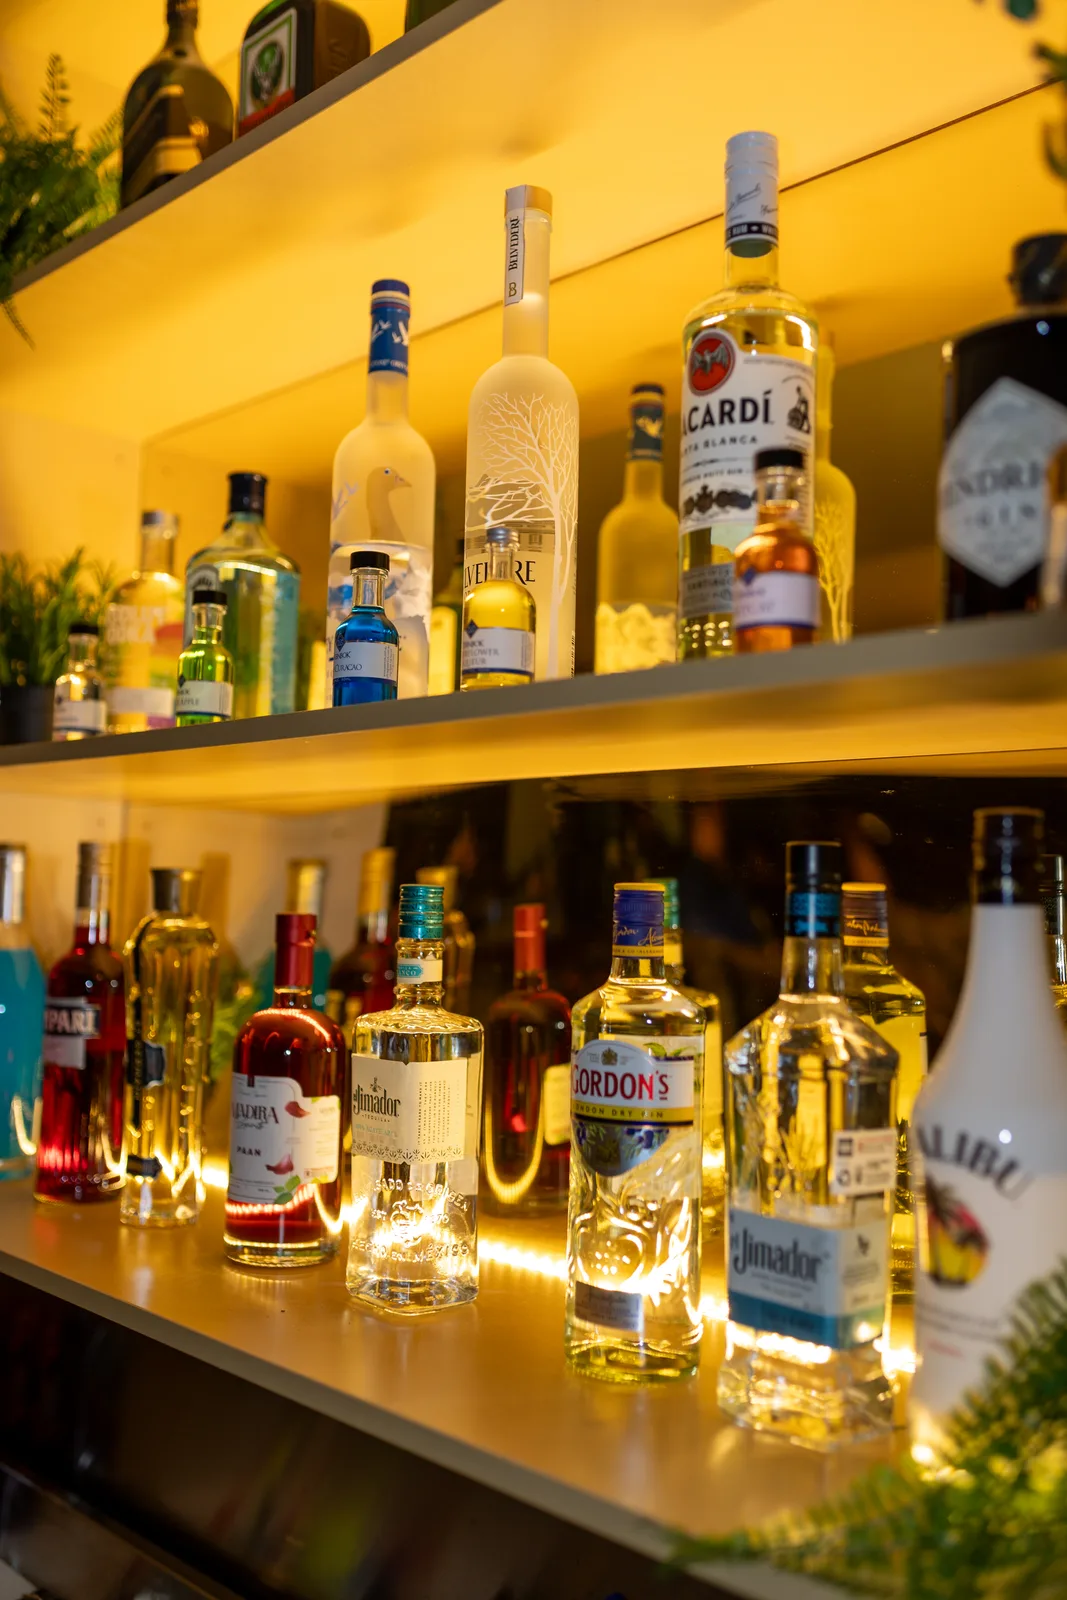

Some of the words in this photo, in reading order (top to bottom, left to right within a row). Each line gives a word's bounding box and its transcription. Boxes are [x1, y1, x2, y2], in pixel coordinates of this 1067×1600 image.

[508, 216, 520, 271] BELVEDERE
[572, 1063, 670, 1100] GORDON'S
[353, 1084, 401, 1118] Jimador
[612, 1109, 633, 1118] DRY
[733, 1228, 823, 1284] Jimador
